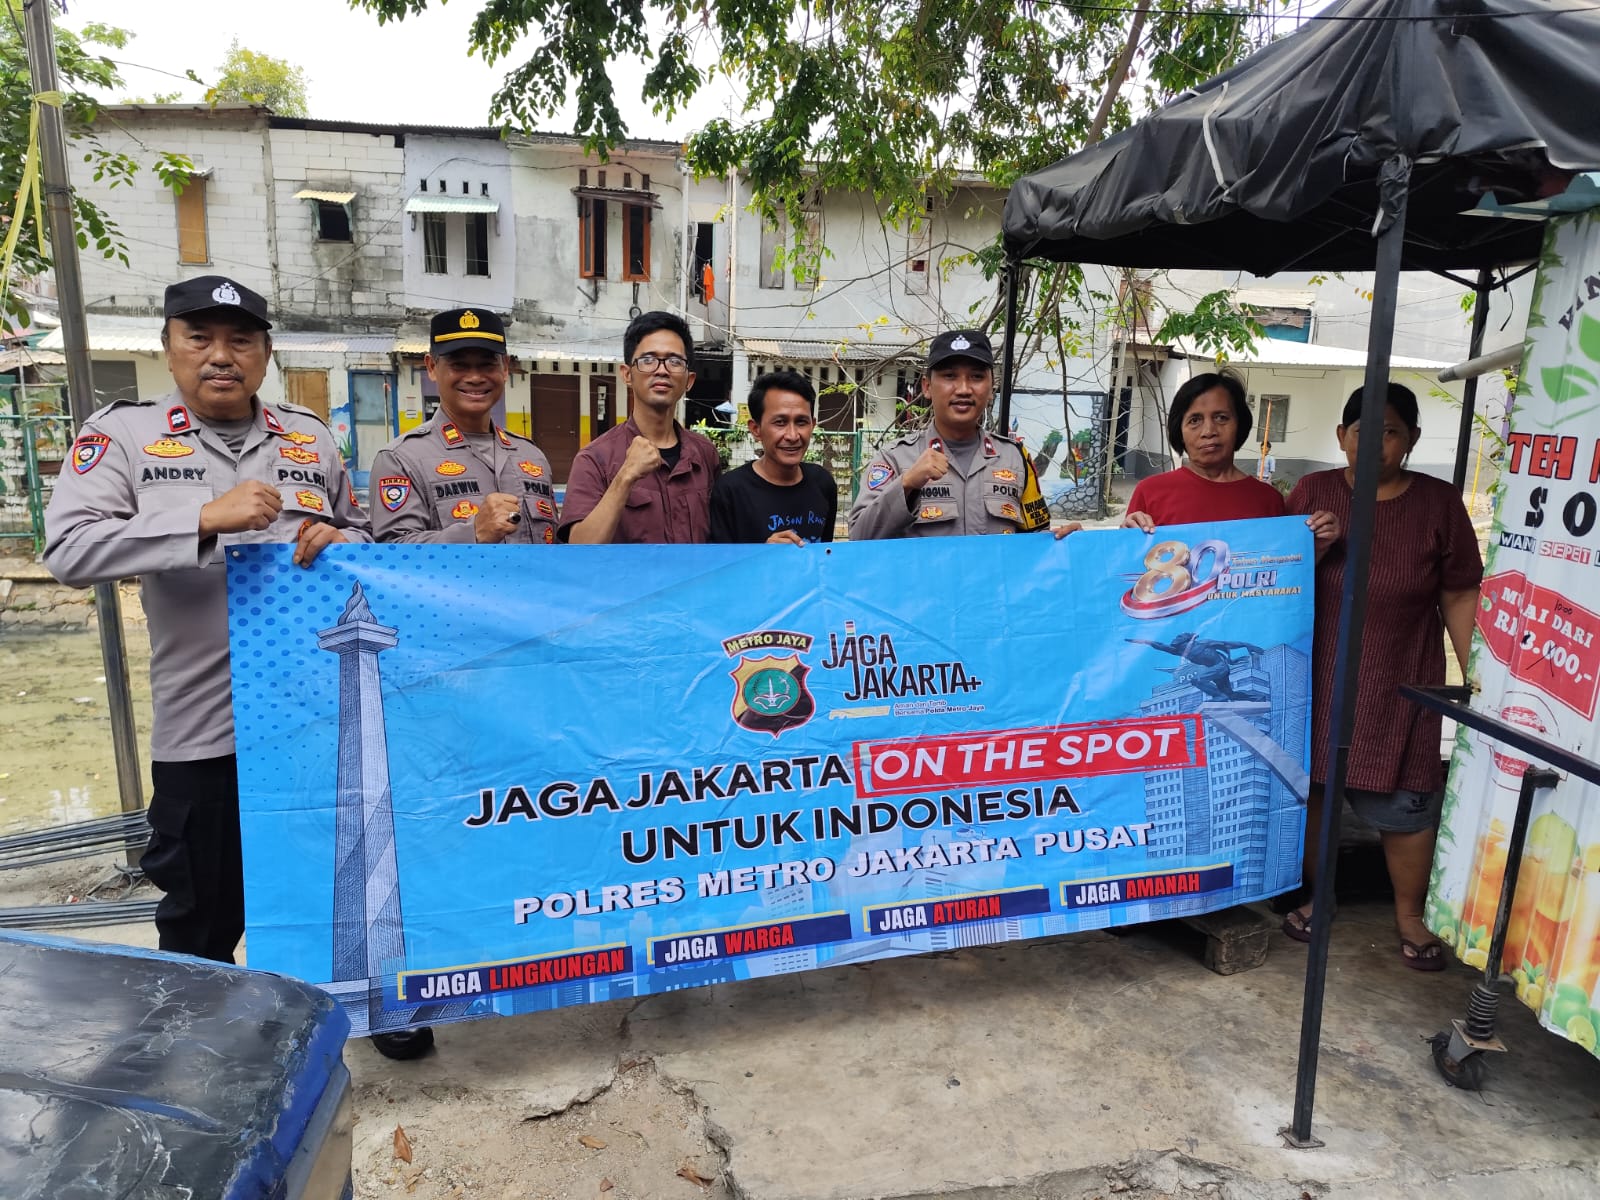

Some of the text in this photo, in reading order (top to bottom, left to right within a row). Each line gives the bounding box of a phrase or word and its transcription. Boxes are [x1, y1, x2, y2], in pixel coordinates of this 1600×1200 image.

[141, 466, 206, 481] ANDRY
[1507, 432, 1578, 481] TEH
[277, 468, 325, 489] POLRI
[435, 481, 480, 498] DARWIN
[767, 514, 803, 532] JASON
[1540, 541, 1591, 563] SEPET
[1132, 539, 1230, 603] 80
[1217, 570, 1277, 590] POLRI
[1206, 586, 1302, 601] UNTUK MASYARAKAT
[726, 633, 808, 654] METRO JAYA
[1551, 614, 1595, 648] DARI
[821, 628, 898, 670] JAGA
[925, 707, 946, 715] Polda
[968, 705, 985, 713] Jaya
[463, 727, 1182, 828] JAGA JAKARTA ON THE SPOT
[620, 784, 1082, 863] UNTUK INDONESIA
[513, 822, 1157, 926] POLRES METRO JAKARTA PUSAT
[1074, 872, 1202, 906] JAGA AMANAH
[878, 895, 1002, 932] JAGA ATURAN
[663, 923, 795, 963] JAGA WARGA
[419, 948, 625, 999] JAGA LINGKUNGAN
